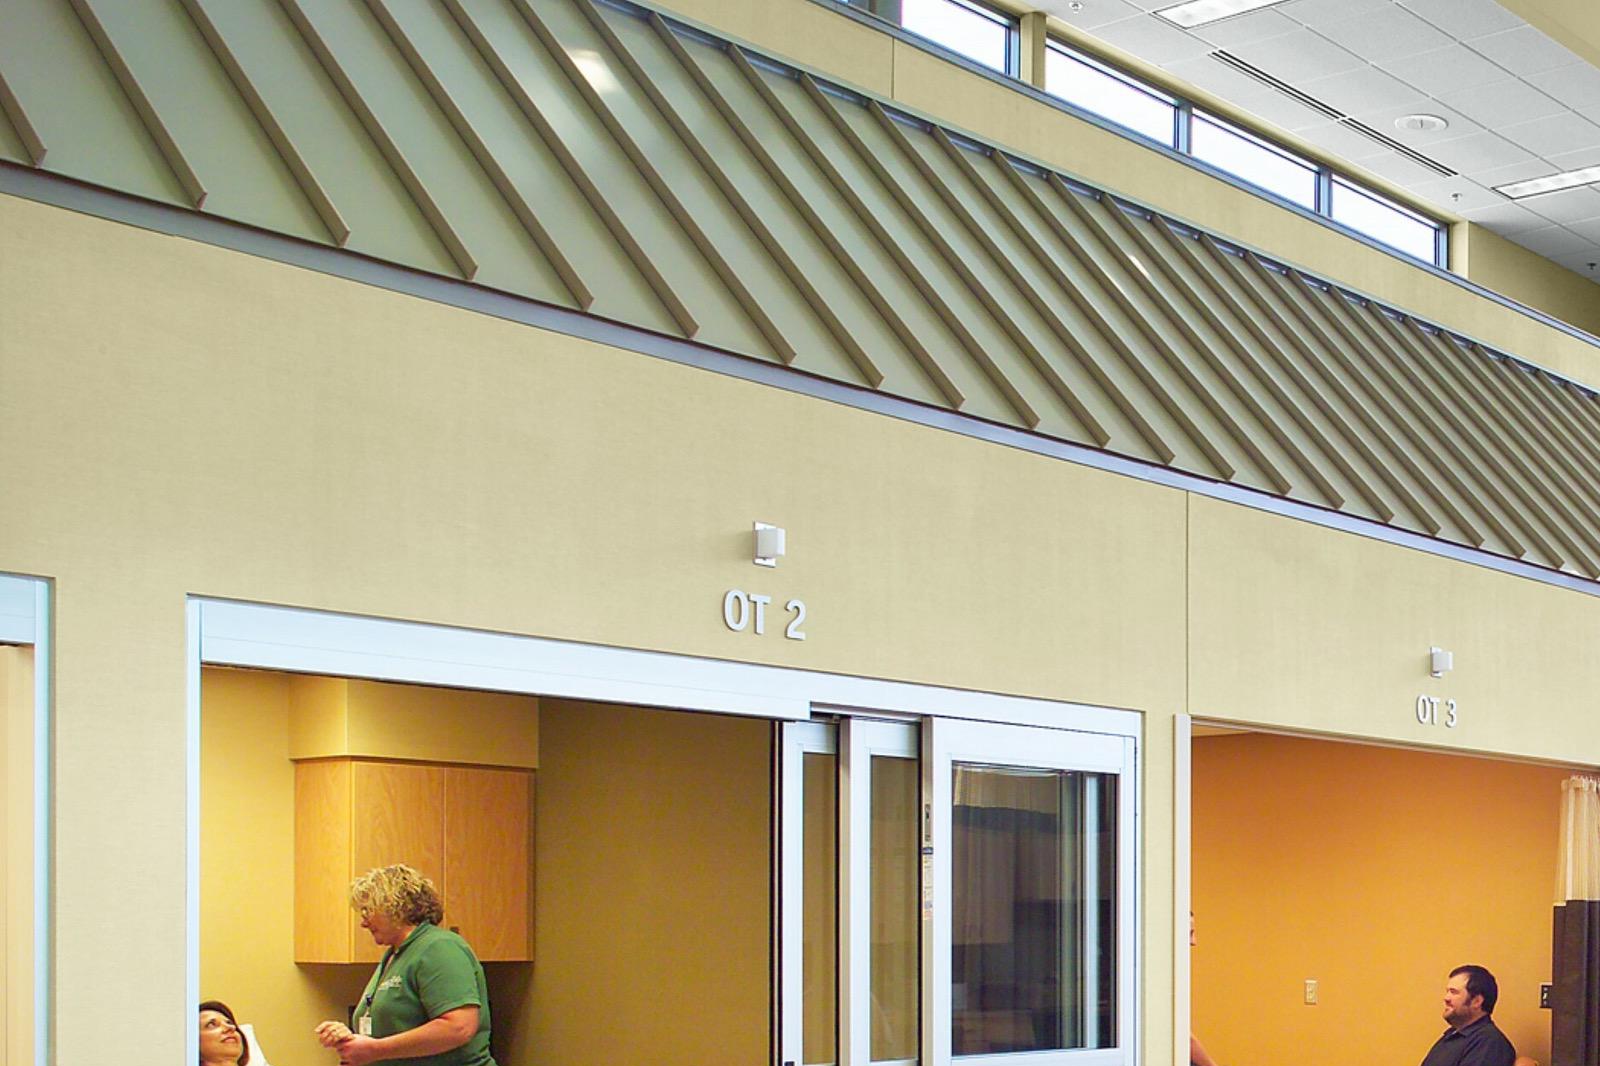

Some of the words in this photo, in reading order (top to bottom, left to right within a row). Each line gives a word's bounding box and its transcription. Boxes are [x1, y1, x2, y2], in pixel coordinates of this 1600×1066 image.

[723, 589, 772, 635] OT
[784, 598, 807, 641] 2
[1416, 694, 1440, 726] OT
[1445, 698, 1457, 729] 3
